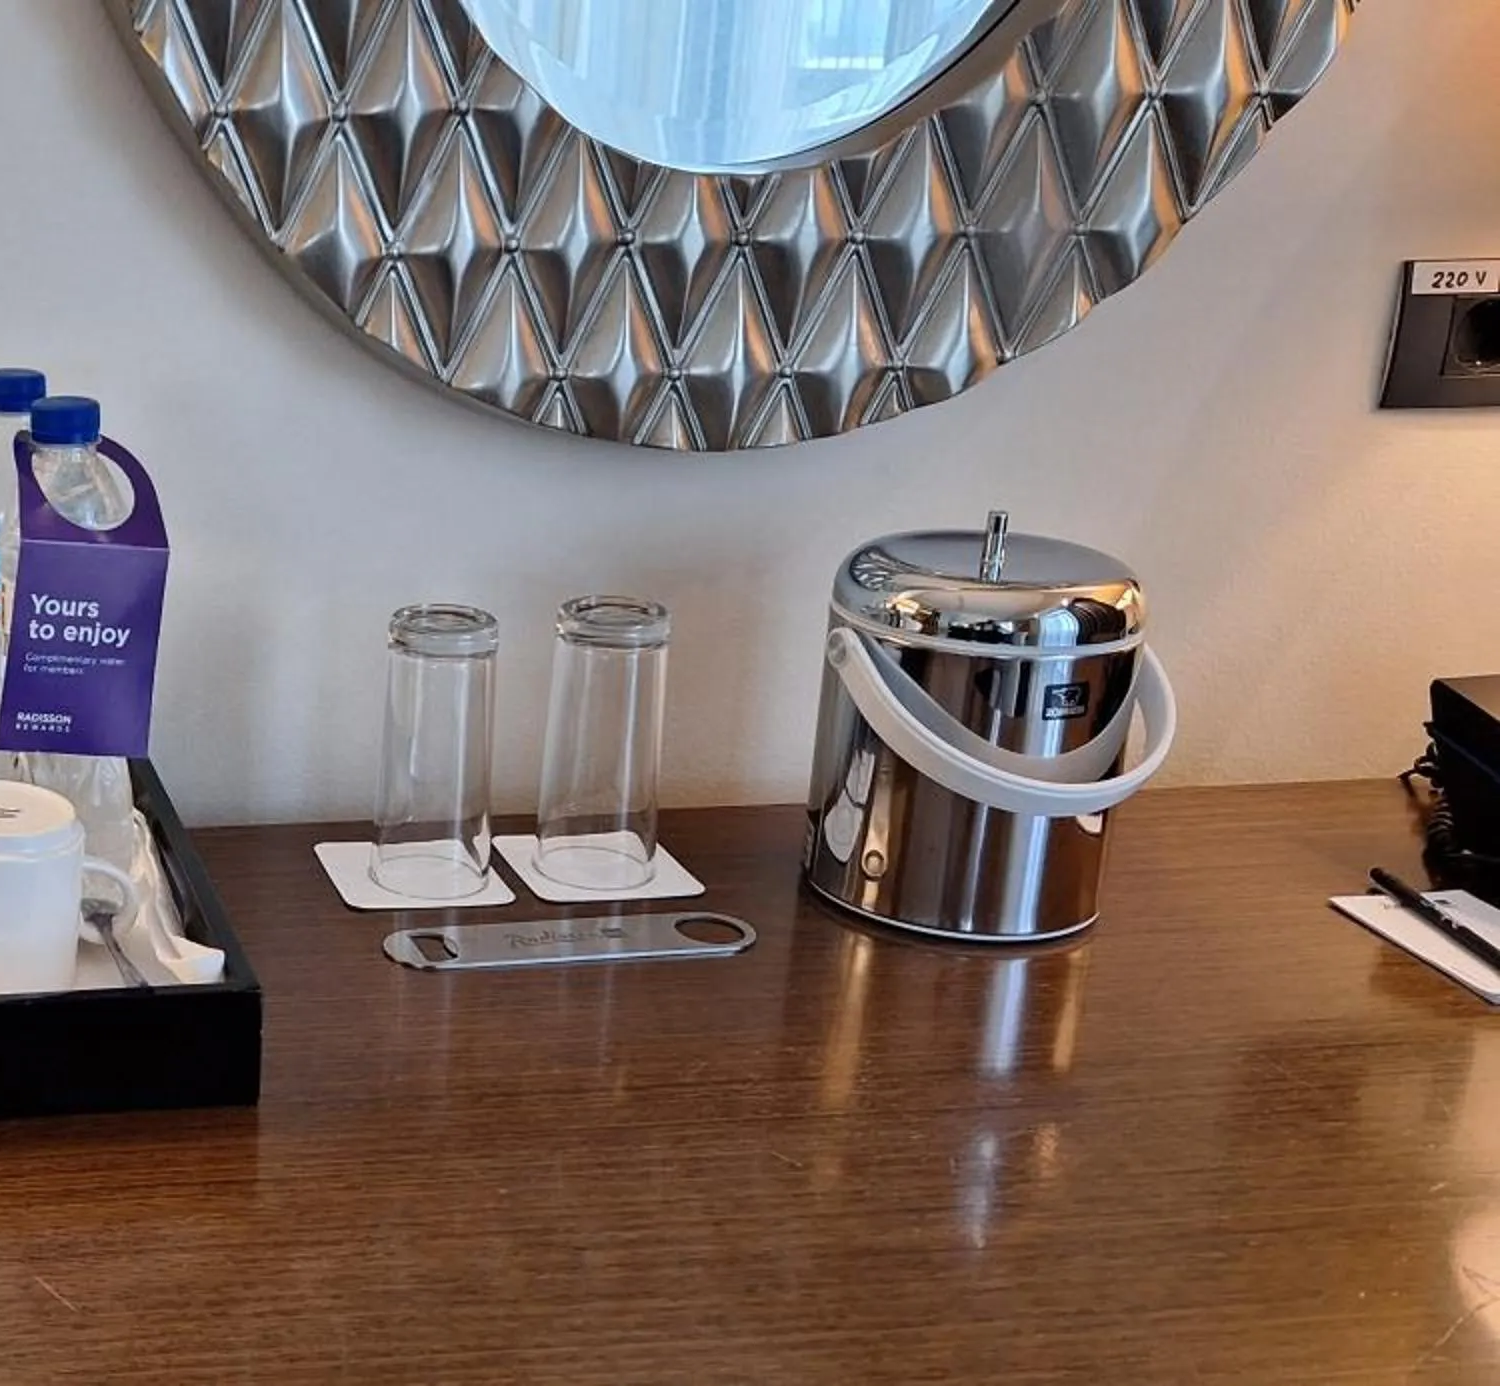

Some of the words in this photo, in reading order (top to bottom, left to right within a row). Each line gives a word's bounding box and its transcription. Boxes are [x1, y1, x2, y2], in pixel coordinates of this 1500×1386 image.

[1431, 270, 1469, 289] 220
[1475, 270, 1487, 286] V
[31, 593, 100, 618] Yours
[29, 619, 55, 640] to
[63, 621, 131, 648] enjoy
[23, 663, 37, 673] for
[16, 711, 73, 724] RADISSON
